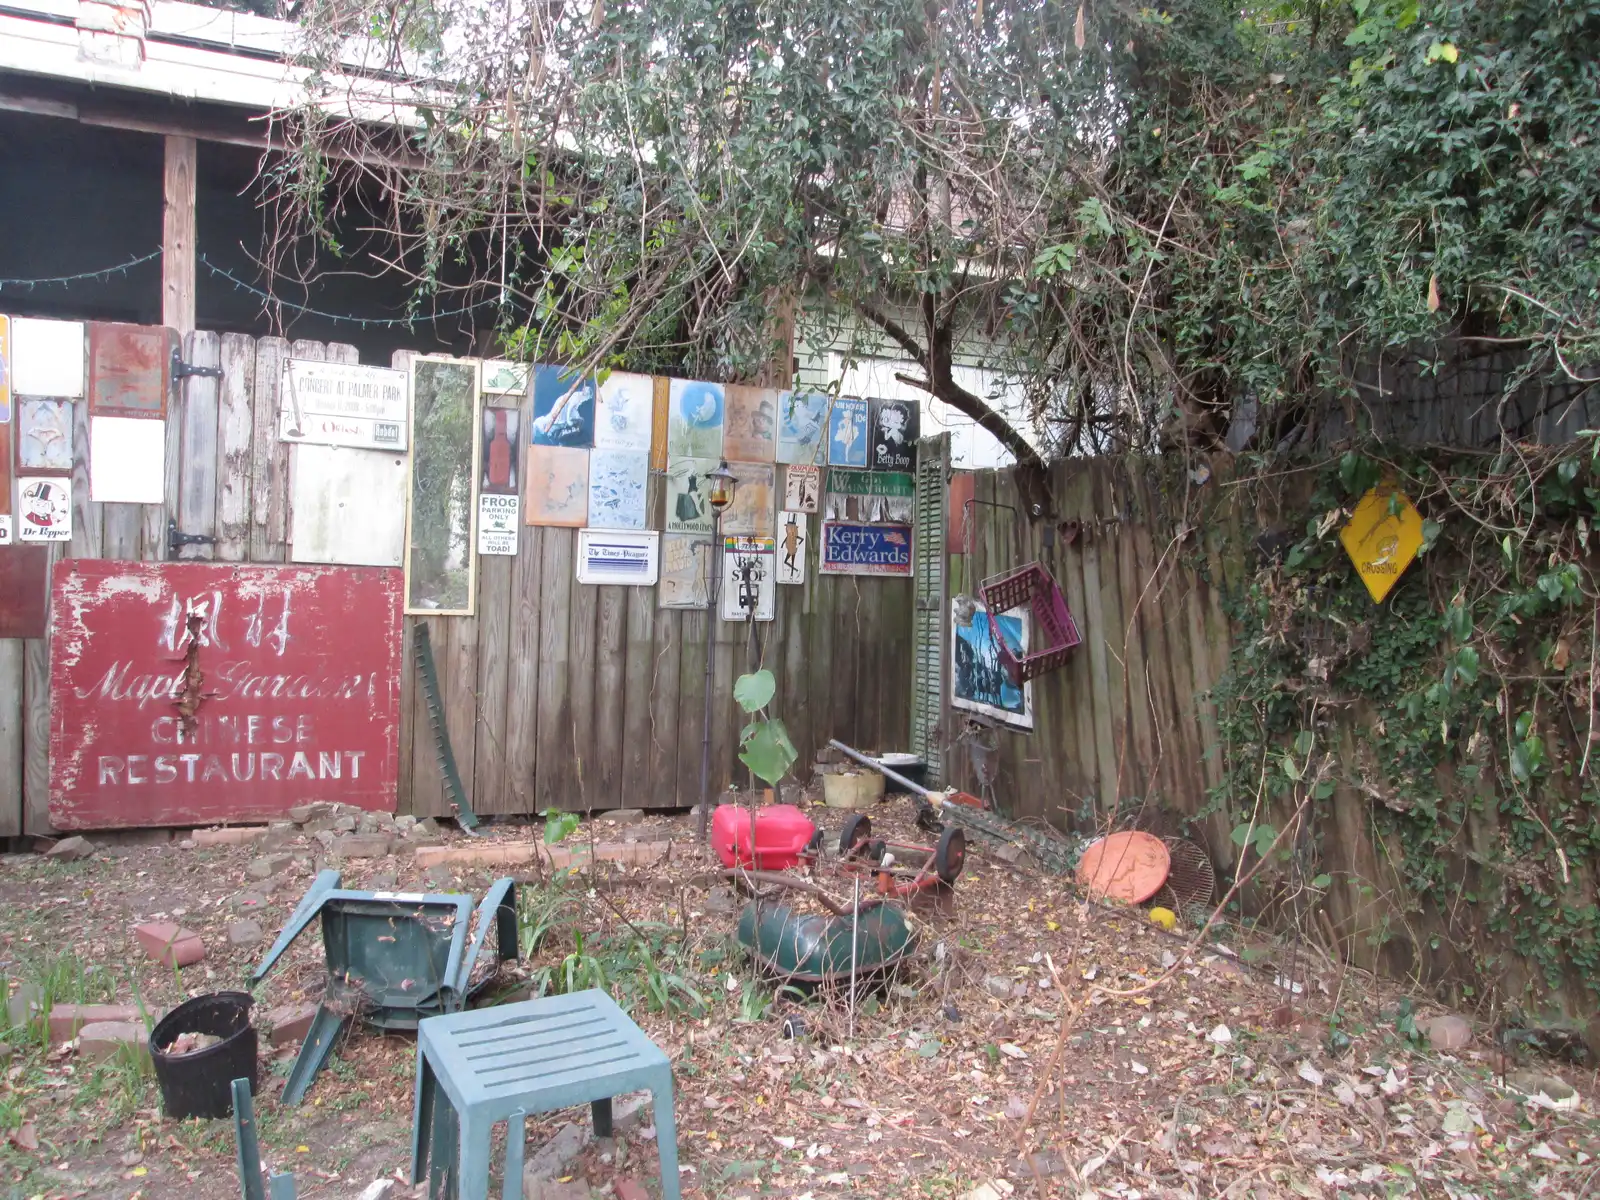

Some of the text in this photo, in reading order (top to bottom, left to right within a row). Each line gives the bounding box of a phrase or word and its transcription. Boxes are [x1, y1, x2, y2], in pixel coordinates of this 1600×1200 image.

[298, 377, 402, 402] CONCERT AT PALMER PARK
[877, 453, 910, 468] Betty Boop
[482, 497, 517, 508] FROG
[481, 507, 517, 515] PARKING
[23, 526, 70, 539] Dr Pepper
[827, 525, 880, 550] Kerry
[588, 547, 600, 556] The
[826, 545, 909, 564] Edwards
[1361, 562, 1398, 575] CROSSING
[74, 660, 190, 709] Mapl
[98, 751, 366, 785] RESTAURANT
